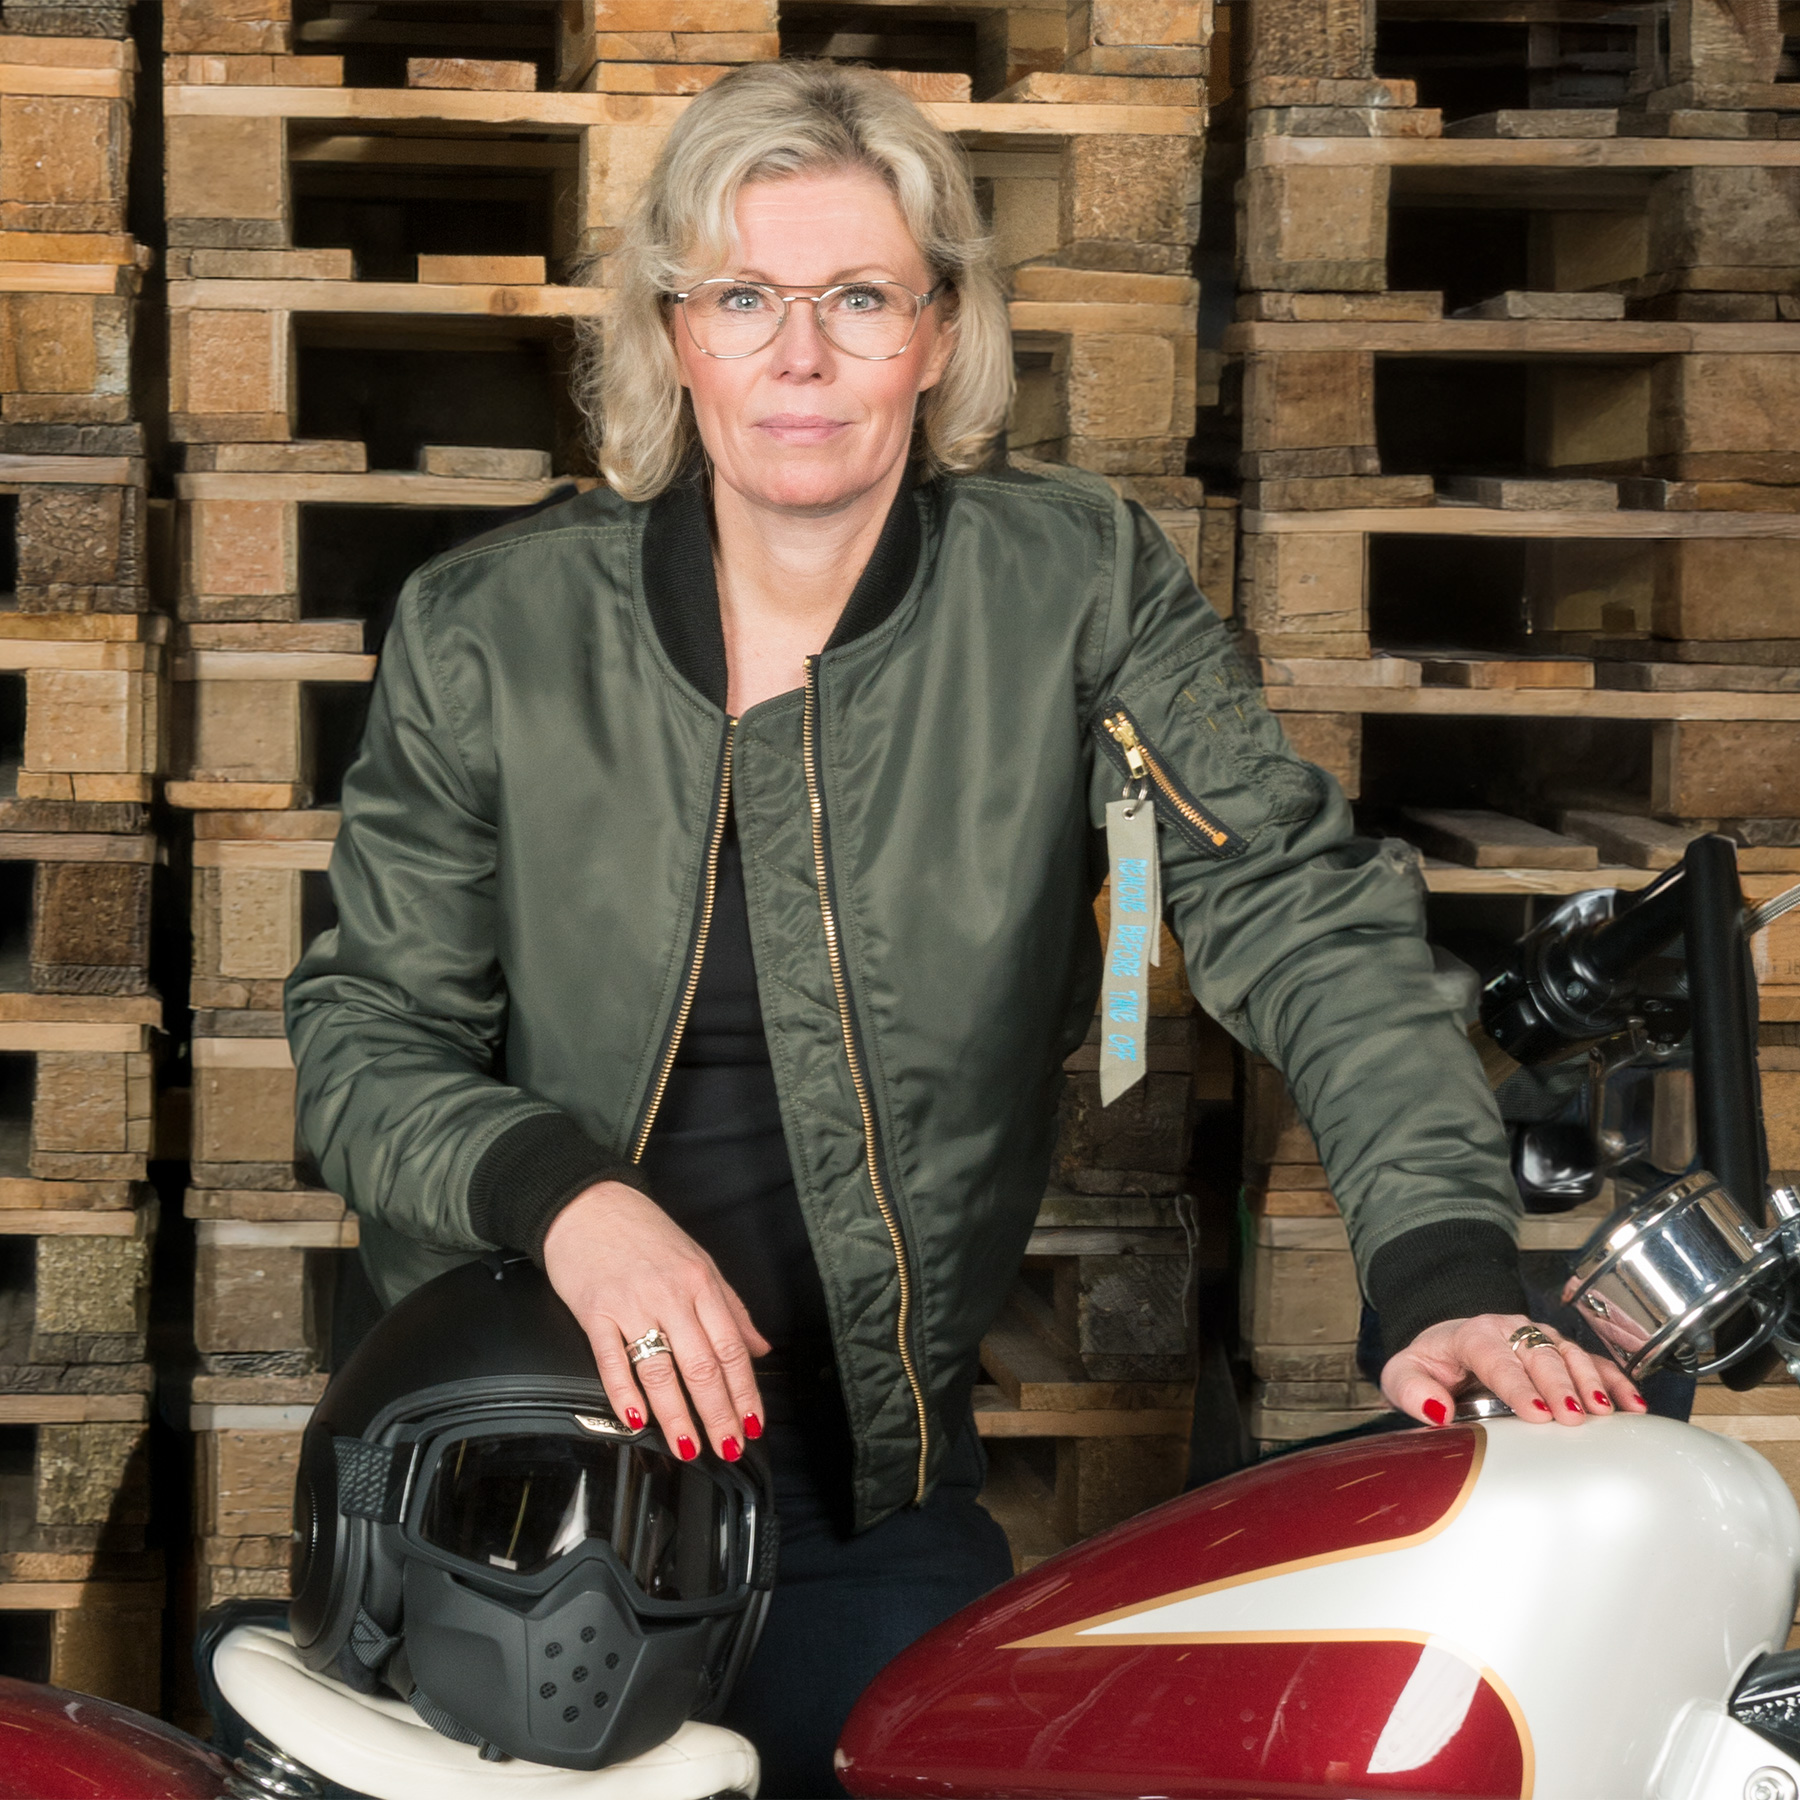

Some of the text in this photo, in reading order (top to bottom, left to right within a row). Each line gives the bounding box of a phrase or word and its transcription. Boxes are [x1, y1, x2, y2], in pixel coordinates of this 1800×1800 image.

[1107, 858, 1148, 1062] REMOVE BEFORE TAKE OFF
